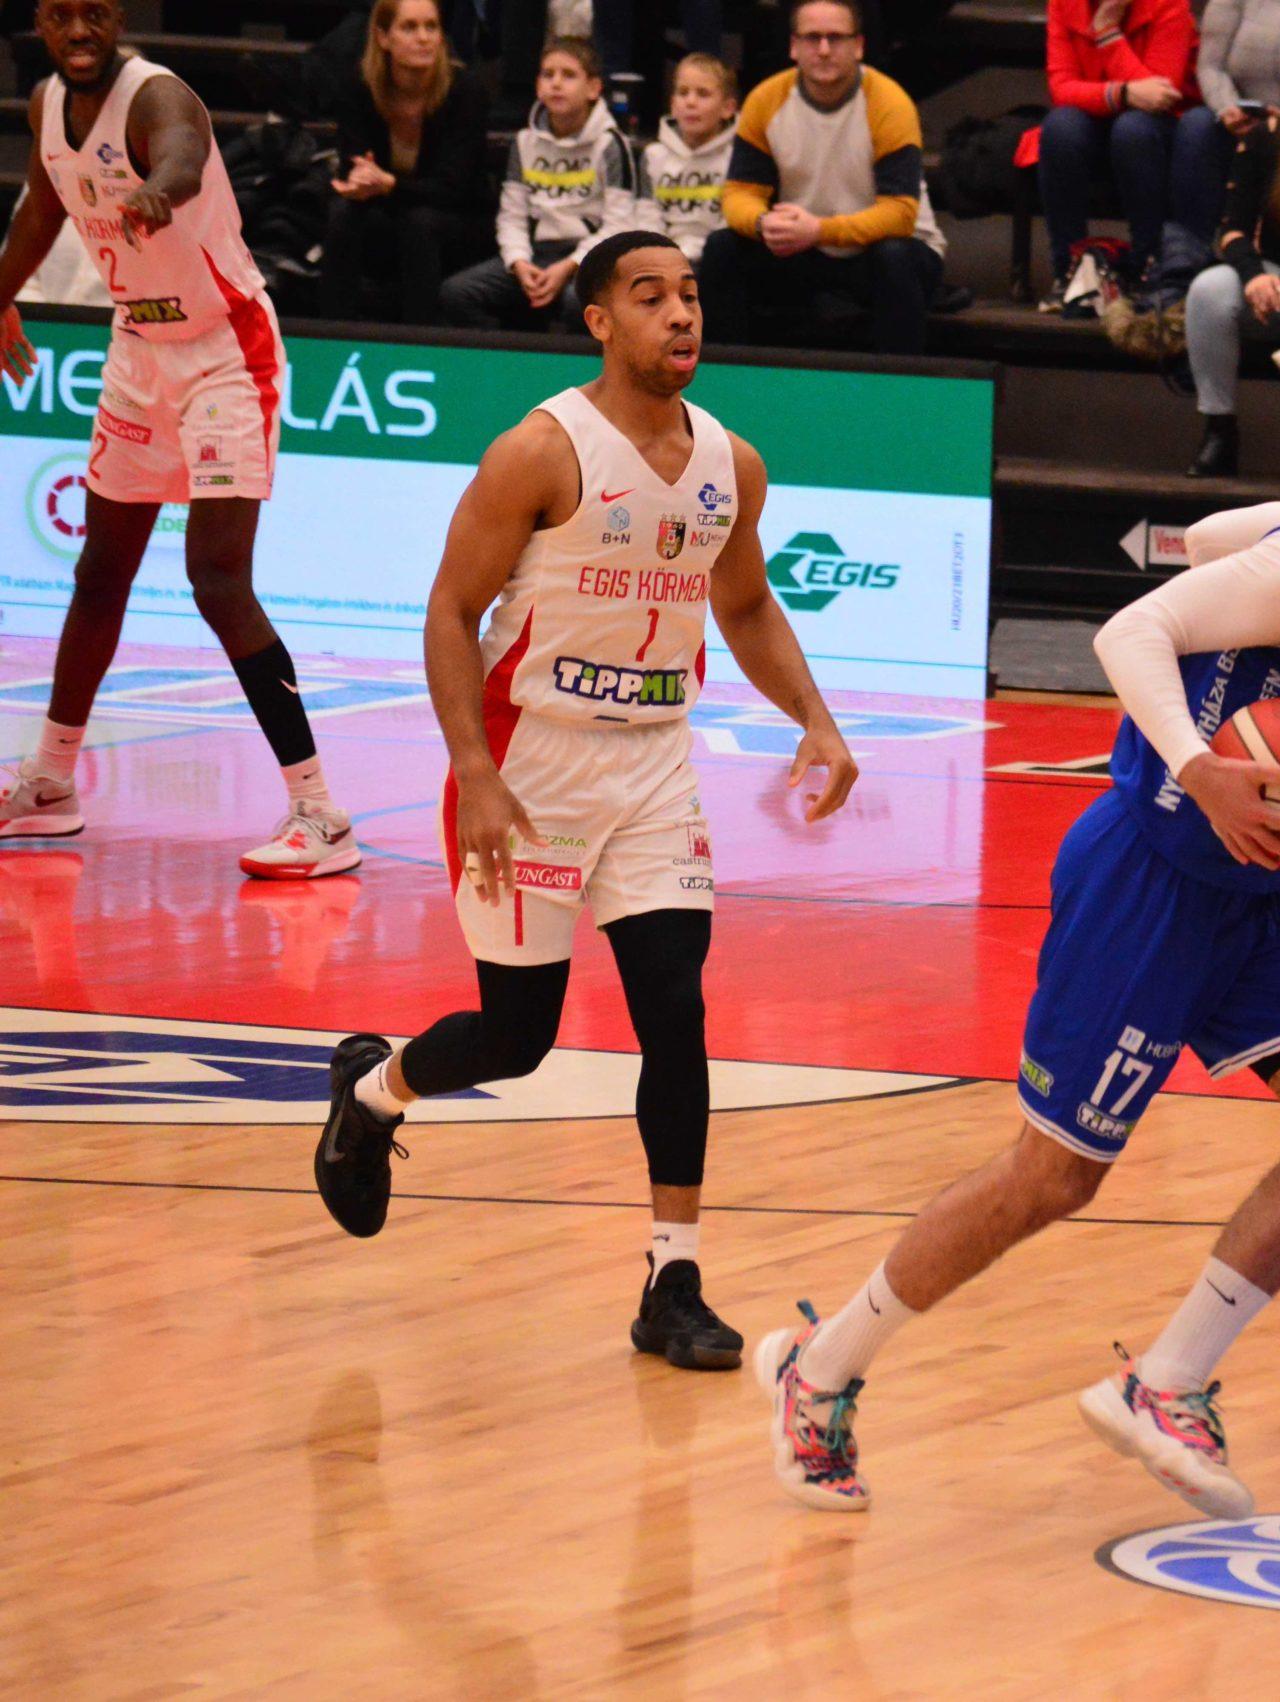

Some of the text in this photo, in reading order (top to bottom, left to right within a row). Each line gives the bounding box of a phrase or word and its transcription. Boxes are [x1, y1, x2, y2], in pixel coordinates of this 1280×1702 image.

[99, 247, 127, 292] 2
[89, 432, 107, 480] 2
[602, 533, 631, 545] B+N
[577, 566, 710, 602] EGIS KÖRMEN
[805, 560, 902, 590] EGIS
[635, 608, 660, 662] 1
[1090, 1049, 1154, 1117] 17
